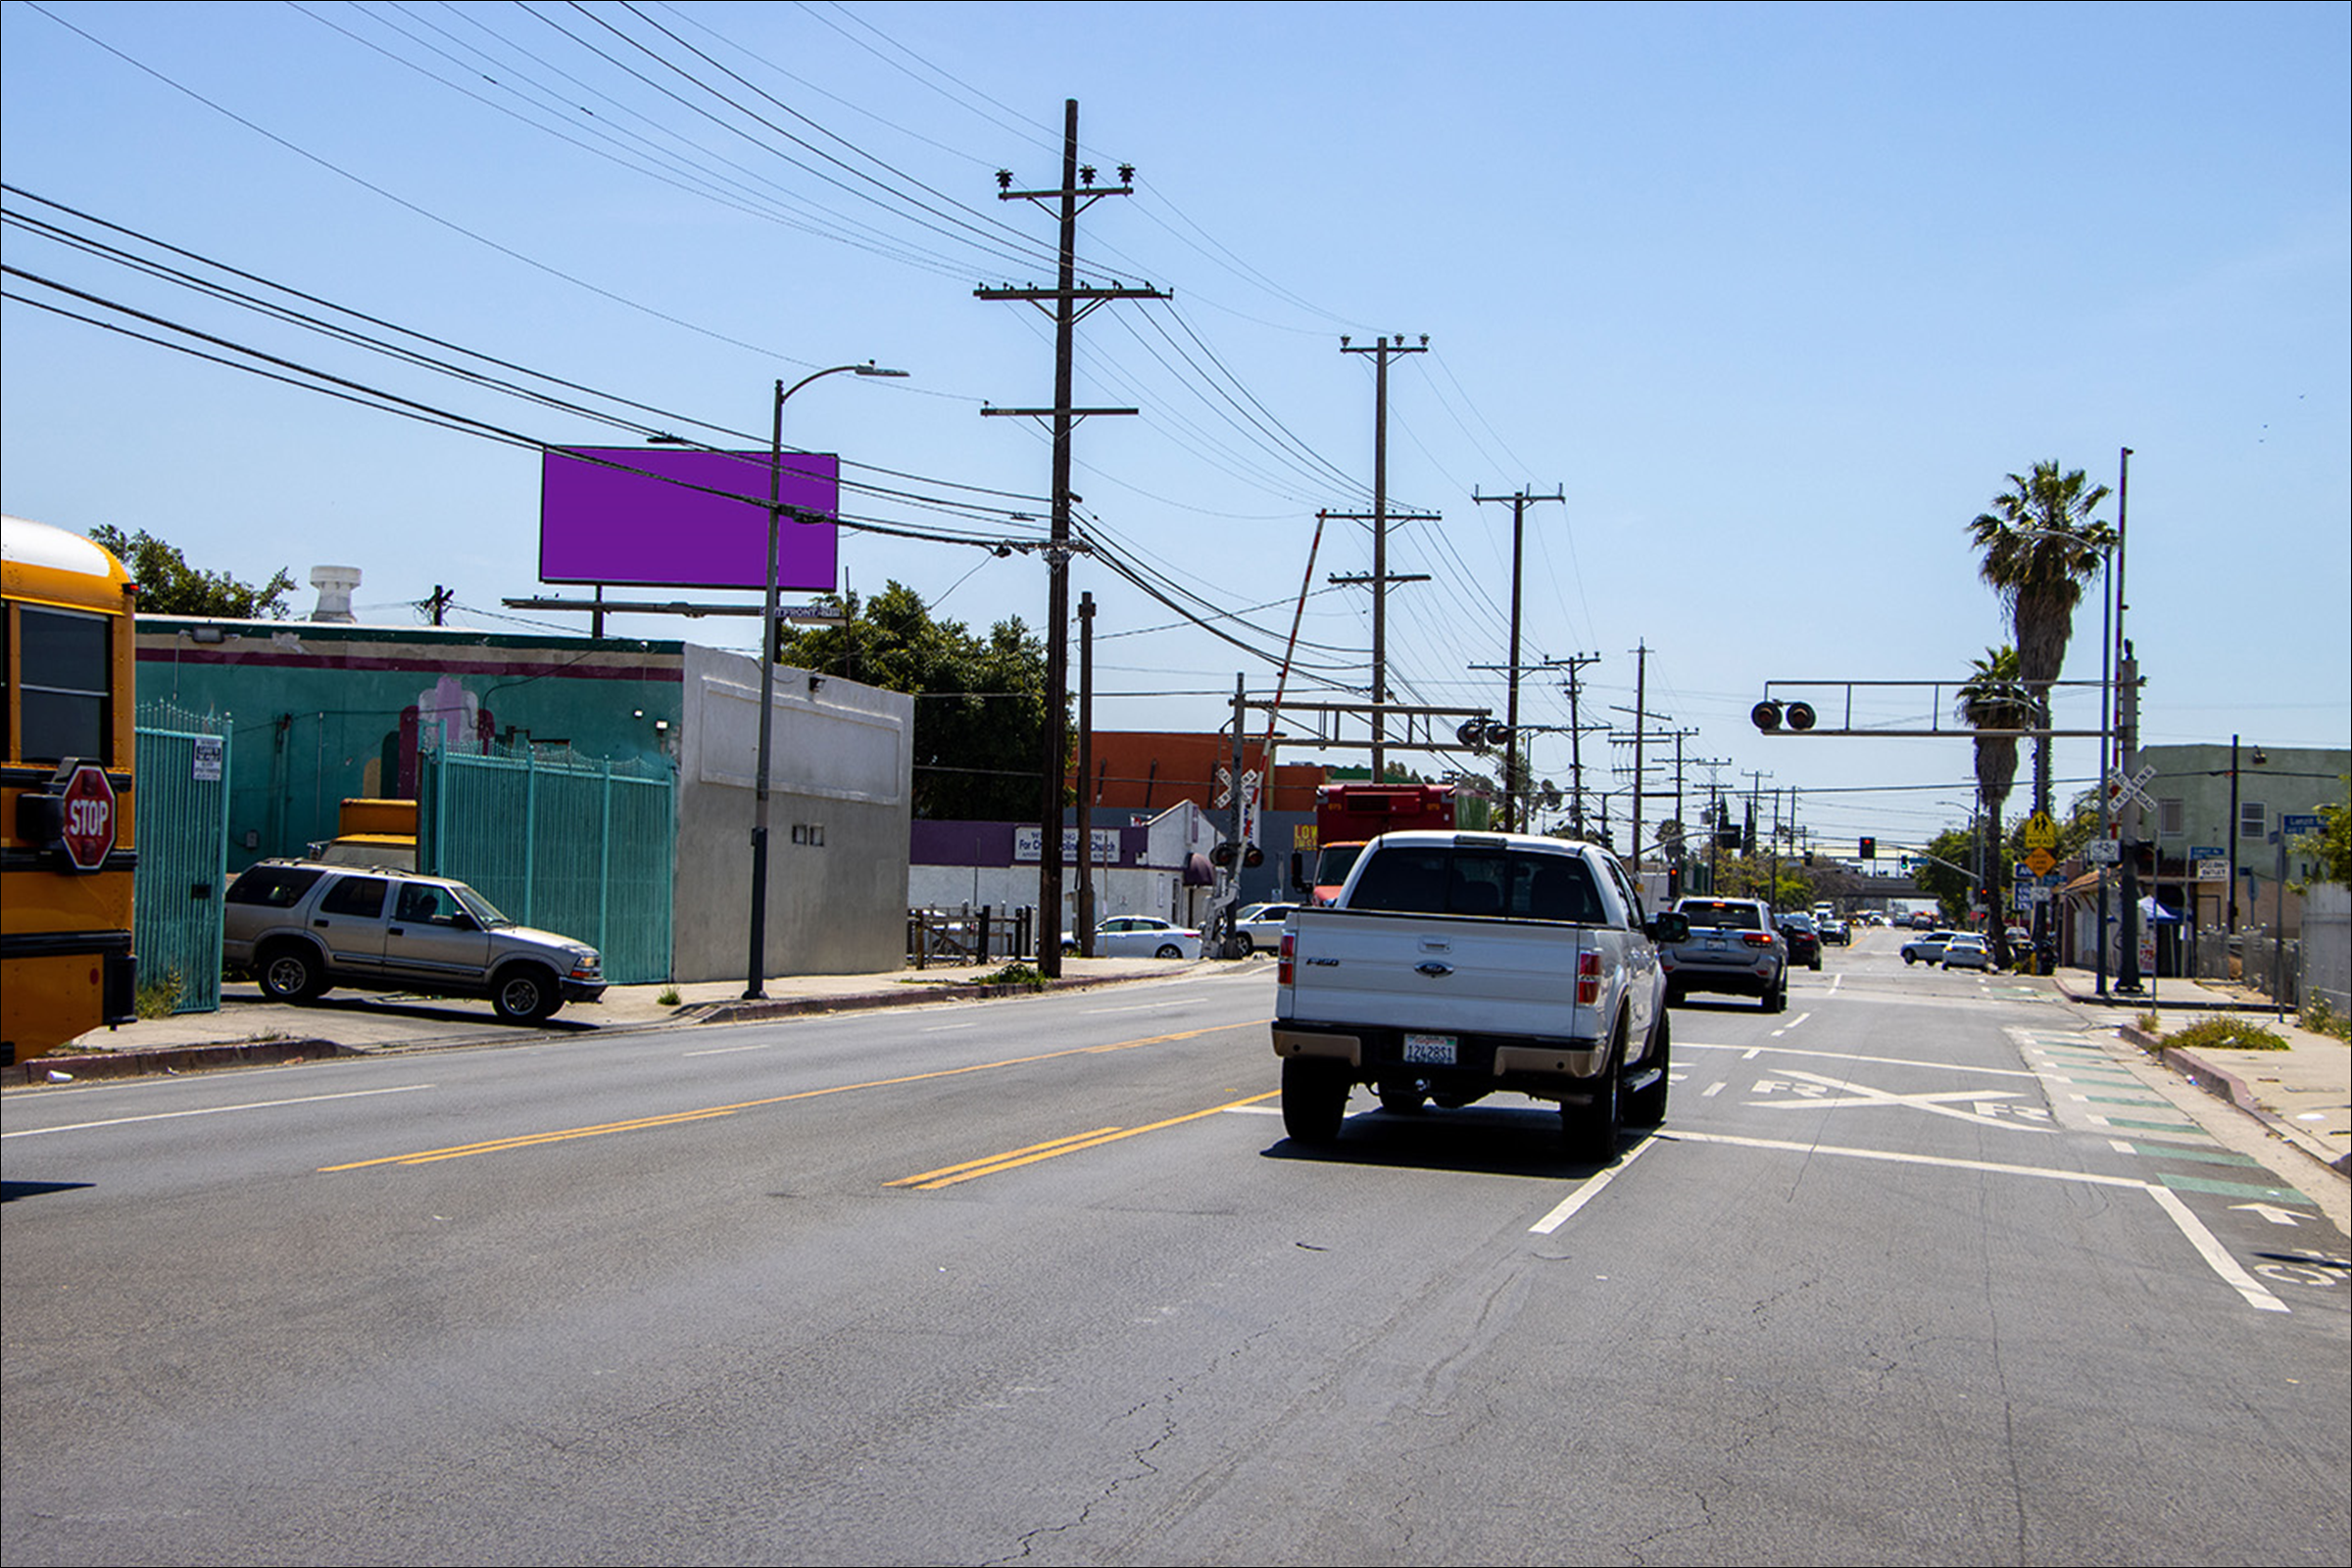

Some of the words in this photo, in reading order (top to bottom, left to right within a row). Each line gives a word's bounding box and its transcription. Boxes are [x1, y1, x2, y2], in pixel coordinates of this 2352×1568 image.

[2109, 766, 2154, 810] CROSSING
[70, 799, 109, 836] STOP
[1294, 824, 1318, 839] LOW
[1019, 839, 1032, 851] For
